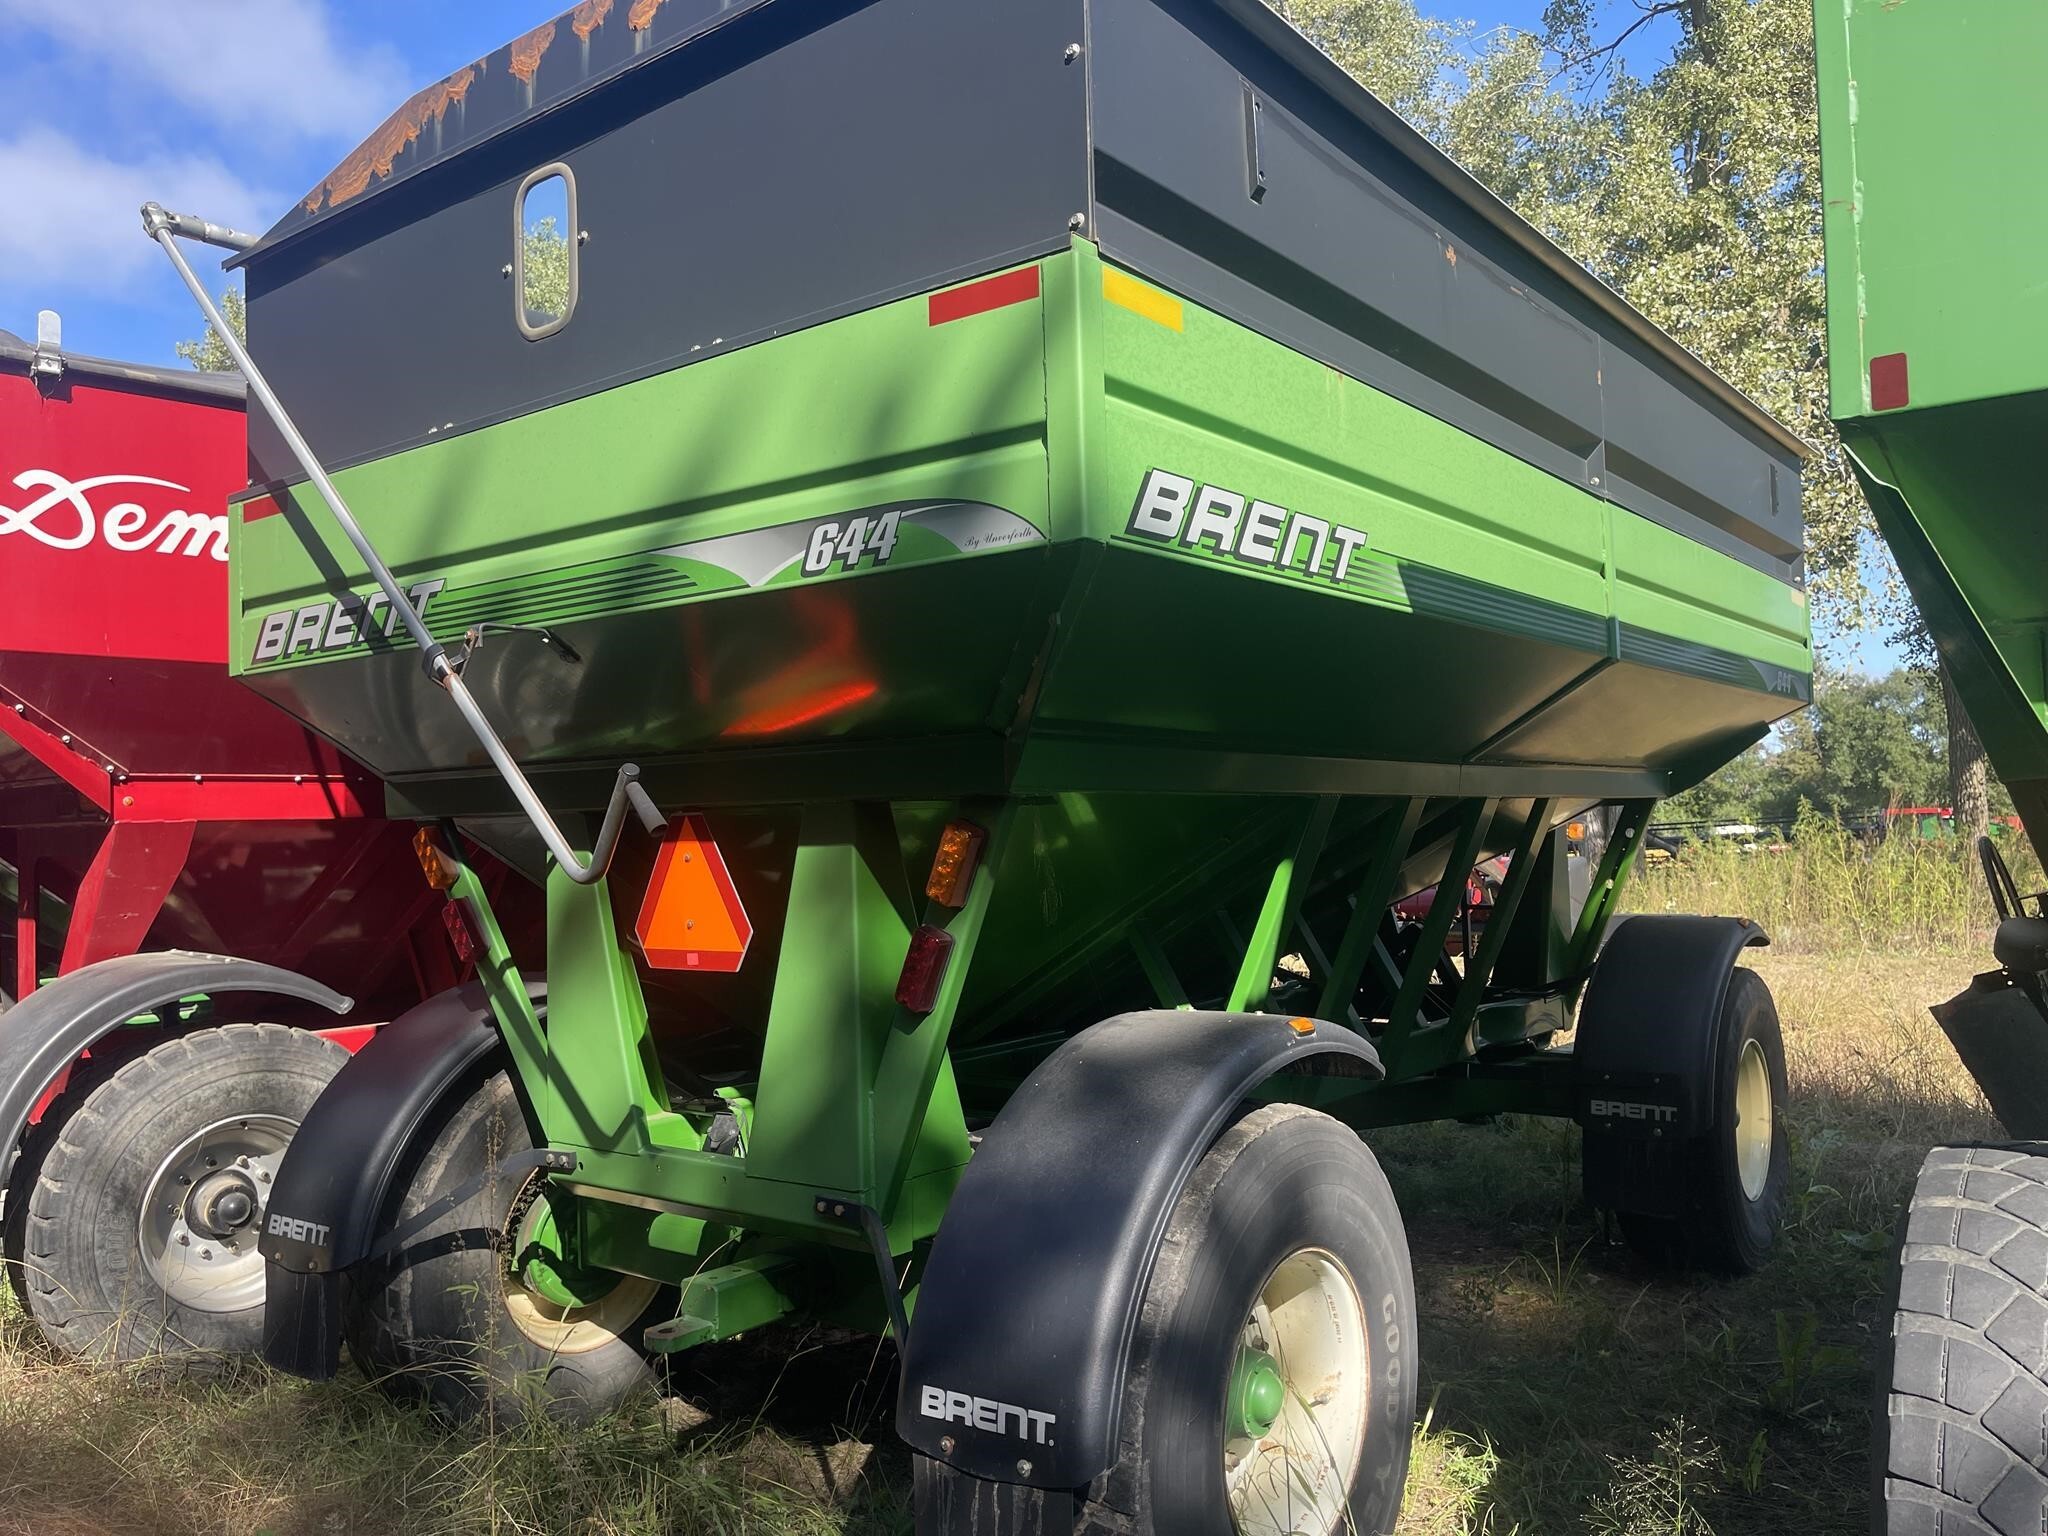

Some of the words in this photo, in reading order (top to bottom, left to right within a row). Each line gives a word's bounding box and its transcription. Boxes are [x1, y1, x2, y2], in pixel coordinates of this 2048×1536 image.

[802, 510, 901, 577] 644
[964, 536, 980, 549] By
[1124, 467, 1368, 584] BRENT
[252, 578, 446, 662] BRENT
[1590, 1100, 1678, 1122] BRENT
[268, 1213, 331, 1246] BRENT
[921, 1385, 1056, 1447] BRENT
